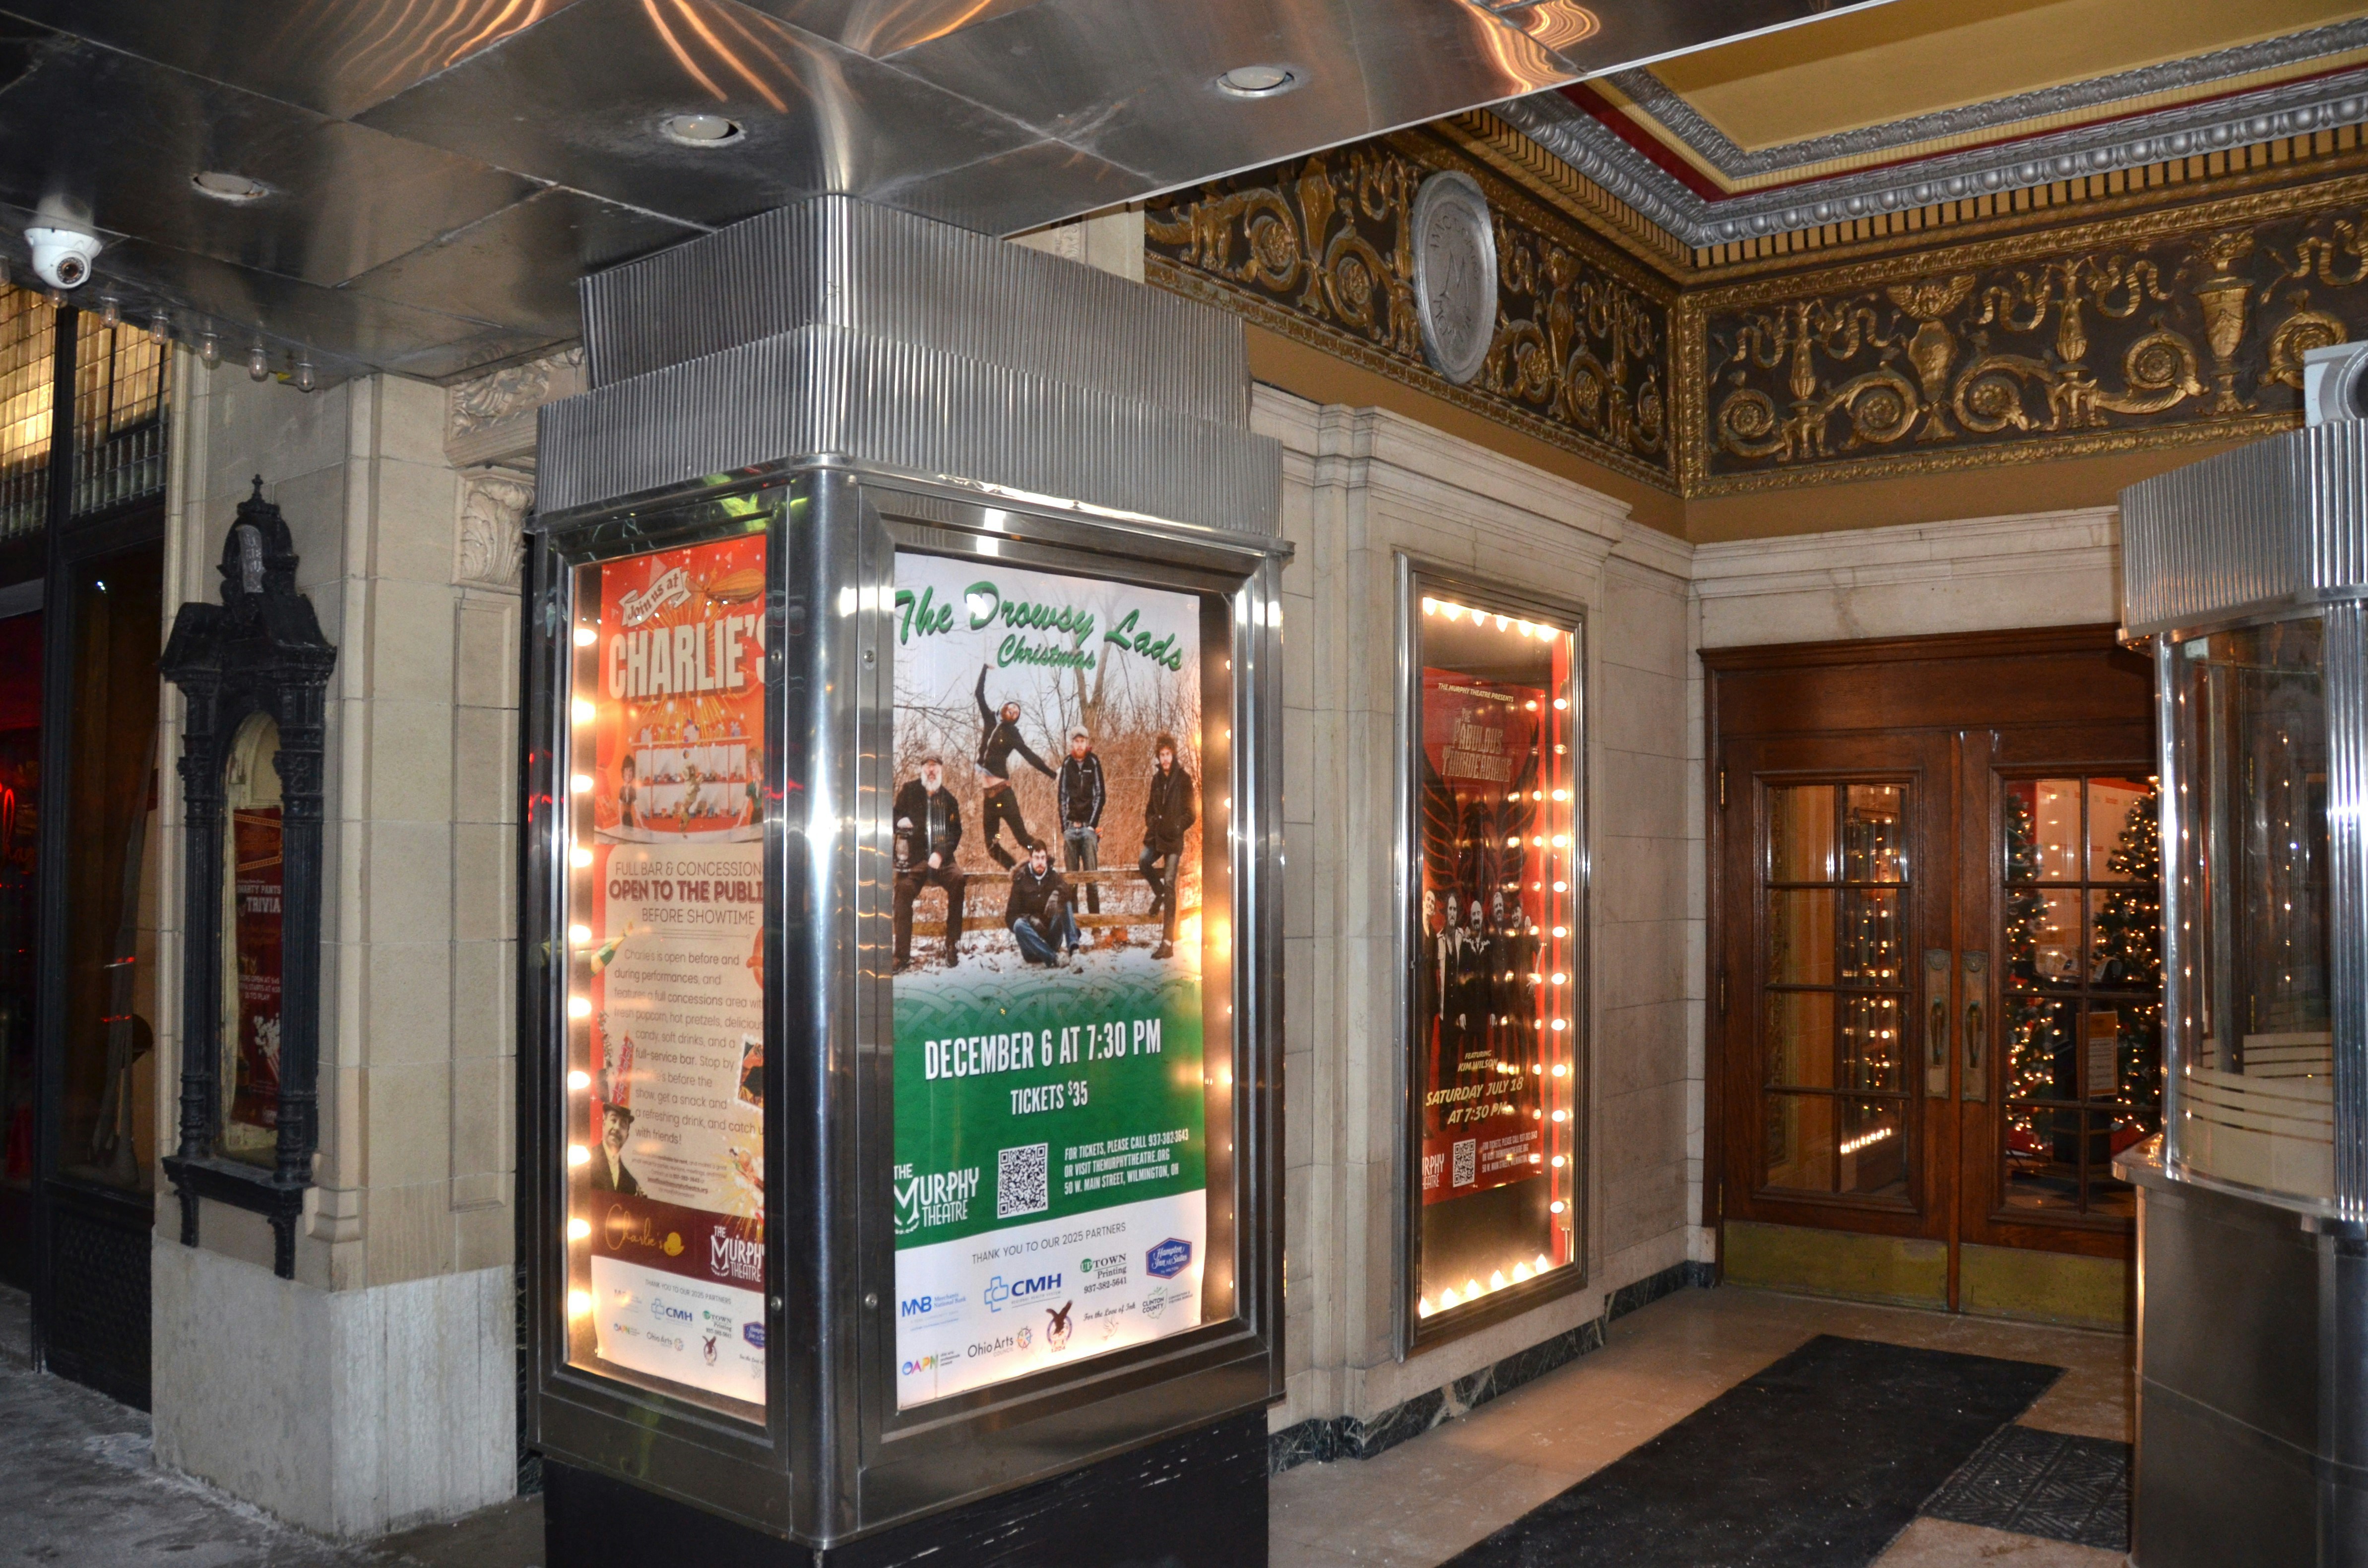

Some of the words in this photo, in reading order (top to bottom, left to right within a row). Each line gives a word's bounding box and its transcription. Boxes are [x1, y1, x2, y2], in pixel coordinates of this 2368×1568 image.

[627, 599, 651, 620] Join
[651, 584, 664, 602] us
[667, 573, 679, 590] at
[895, 585, 953, 645] The
[964, 581, 1094, 647] Drowsy
[1104, 609, 1182, 671] Lads
[997, 633, 1095, 670] Christmas
[1438, 683, 1449, 691] THE
[1448, 684, 1471, 695] MURPHY
[1470, 688, 1491, 699] THEATRE
[1491, 692, 1514, 702] PRESENTS
[1452, 717, 1504, 754] FABULOUS
[1442, 745, 1512, 782] THUNDERBIRDS
[615, 862, 639, 876] FULL
[641, 862, 662, 876] BAR
[666, 862, 673, 876] &
[260, 884, 282, 894] PANTS
[609, 879, 649, 901] OPEN
[651, 880, 674, 902] TO
[676, 880, 710, 903] THE
[246, 896, 282, 914] TRIVIA
[642, 908, 683, 923] BEFORE
[687, 909, 756, 925] SHOWTIME
[657, 951, 662, 961] is
[664, 953, 686, 963] open
[688, 953, 719, 965] before
[721, 954, 739, 965] and
[614, 968, 640, 983] during
[641, 970, 700, 986] performances,
[703, 974, 721, 985] and
[614, 987, 645, 999] features
[654, 990, 666, 1001] full
[667, 993, 723, 1006] concessions
[725, 998, 747, 1008] area
[614, 1007, 634, 1018] fresh
[636, 1009, 668, 1023] popcorn,
[670, 1012, 683, 1023] hot
[685, 1013, 722, 1030] pretzels,
[636, 1029, 660, 1042] candy,
[661, 1032, 676, 1043] soft
[678, 1034, 705, 1048] drinks,
[707, 1037, 726, 1048] and
[729, 1039, 735, 1049] a
[925, 1031, 1034, 1080] DECEMBER
[1042, 1029, 1053, 1066] 6
[1059, 1026, 1081, 1064] AT
[1087, 1021, 1126, 1061] 7:30
[1134, 1018, 1161, 1055] PM
[635, 1049, 678, 1064] full-service
[680, 1053, 697, 1066] bar.
[699, 1055, 720, 1069] Stop
[723, 1058, 734, 1071] by
[1458, 1062, 1472, 1072] KIM
[1472, 1058, 1499, 1070] WILSON
[1465, 1050, 1492, 1060] FEATURING
[668, 1073, 695, 1085] before
[698, 1075, 713, 1087] the
[636, 1088, 656, 1100] show,
[657, 1092, 670, 1104] get
[672, 1095, 678, 1103] a
[680, 1094, 705, 1107] snack
[708, 1098, 727, 1110] and
[1011, 1084, 1064, 1115] TICKETS
[1068, 1080, 1088, 1106] $35
[1425, 1084, 1484, 1107] SATURDAY
[1486, 1080, 1510, 1096] JULY
[1510, 1076, 1524, 1091] 18
[635, 1108, 641, 1117] a
[642, 1110, 679, 1128] refreshing
[682, 1115, 705, 1129] drink,
[707, 1119, 726, 1130] and
[728, 1122, 756, 1134] catch
[1447, 1109, 1464, 1125] AT
[1464, 1105, 1489, 1123] 7:30
[636, 1128, 651, 1139] with
[652, 1129, 682, 1144] friends!
[1065, 1146, 1078, 1160] FOR
[1079, 1141, 1106, 1159] TICKETS,
[1107, 1138, 1129, 1153] PLEASE
[1130, 1135, 1148, 1149] CALL
[1148, 1129, 1189, 1147] 937-382-3643
[894, 1163, 913, 1180] THE
[1064, 1164, 1074, 1178] OR
[1075, 1160, 1091, 1175] VISIT
[1092, 1148, 1170, 1173] THEMURPHYTHEATRE.ORG
[1064, 1182, 1073, 1195] 50
[1074, 1181, 1083, 1193] W.
[1084, 1176, 1100, 1191] MAIN
[1101, 1172, 1126, 1189] STREET,
[1127, 1165, 1170, 1184] WILMINGTON,
[1171, 1163, 1180, 1176] OH
[894, 1167, 979, 1225] MURPHY
[921, 1199, 968, 1228] THEATRE
[713, 1225, 726, 1238] THE
[710, 1236, 764, 1270] MURPH
[972, 1248, 1000, 1265] THANK
[1003, 1244, 1023, 1257] YOU
[1026, 1241, 1039, 1253] TO
[1041, 1238, 1060, 1250] OUR
[1062, 1231, 1084, 1245] 2025
[1086, 1222, 1126, 1240] PARTNERS
[1152, 1246, 1185, 1260] Hampton
[730, 1262, 761, 1282] THEATRE
[1097, 1266, 1127, 1279] Printing
[645, 1279, 661, 1289] THANK
[661, 1281, 671, 1290] YOU
[672, 1284, 679, 1292] TO
[679, 1287, 690, 1296] OUR
[692, 1290, 704, 1300] 2025
[705, 1293, 732, 1305] PARTNERS
[1012, 1273, 1062, 1297] CMH
[1084, 1277, 1127, 1294] 937-382-5641
[901, 1296, 932, 1317] MNB
[1094, 1310, 1103, 1319] the
[1104, 1308, 1117, 1317] Love
[1118, 1305, 1125, 1314] of
[1142, 1297, 1164, 1308] CLINTON
[1142, 1304, 1164, 1314] COUNTY
[666, 1307, 693, 1321] CMH
[646, 1331, 659, 1341] Ohio
[660, 1335, 673, 1345] Arts
[968, 1343, 993, 1358] Ohio
[993, 1336, 1014, 1352] Arts
[902, 1354, 939, 1376] OAPN
